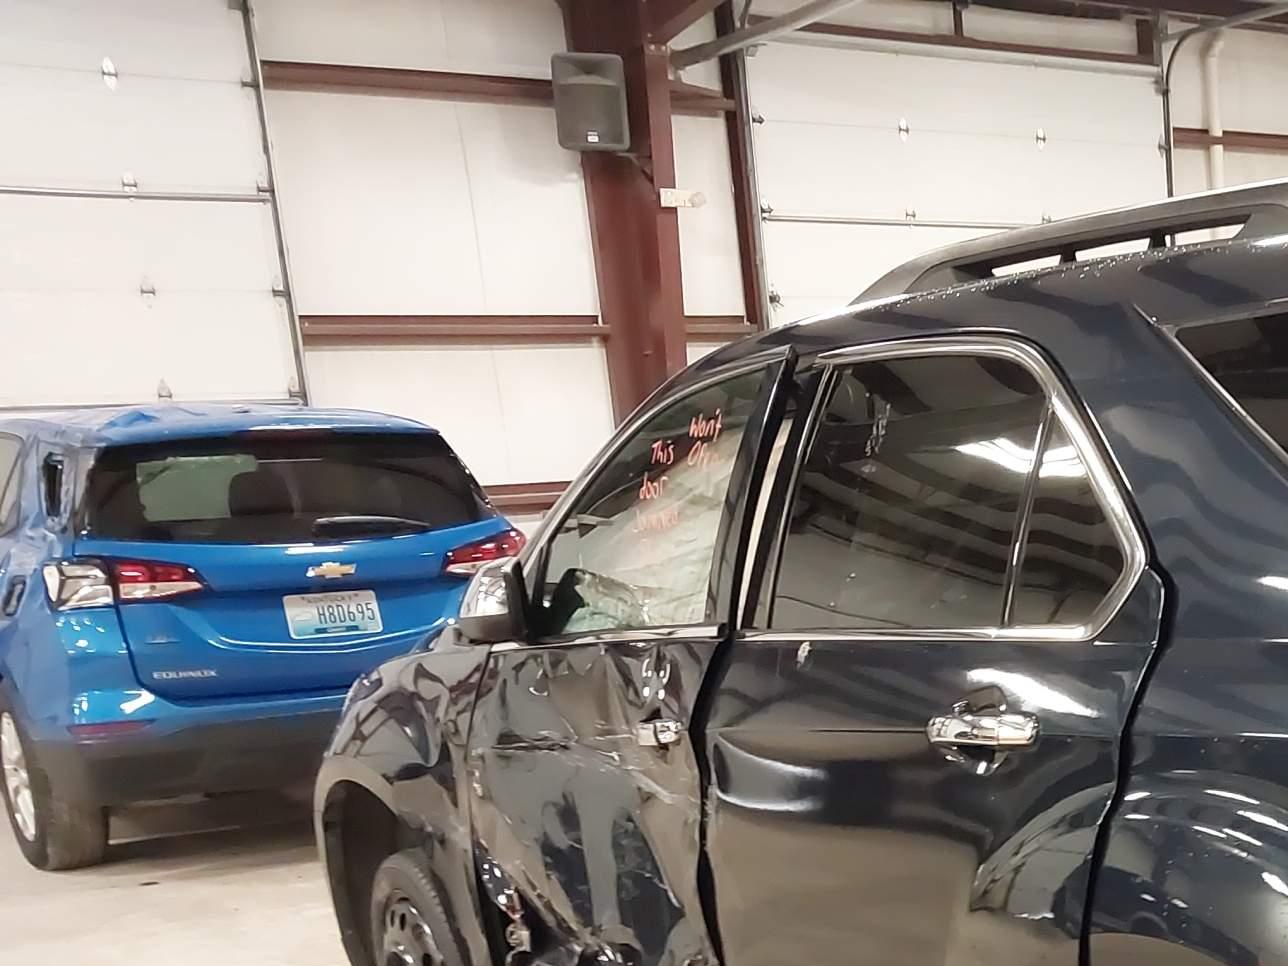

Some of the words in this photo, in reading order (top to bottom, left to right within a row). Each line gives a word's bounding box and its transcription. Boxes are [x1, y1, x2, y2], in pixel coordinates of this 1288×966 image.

[651, 440, 675, 465] This
[639, 472, 669, 500] door
[316, 603, 376, 624] H8D695
[152, 669, 217, 680] EQUINOX
